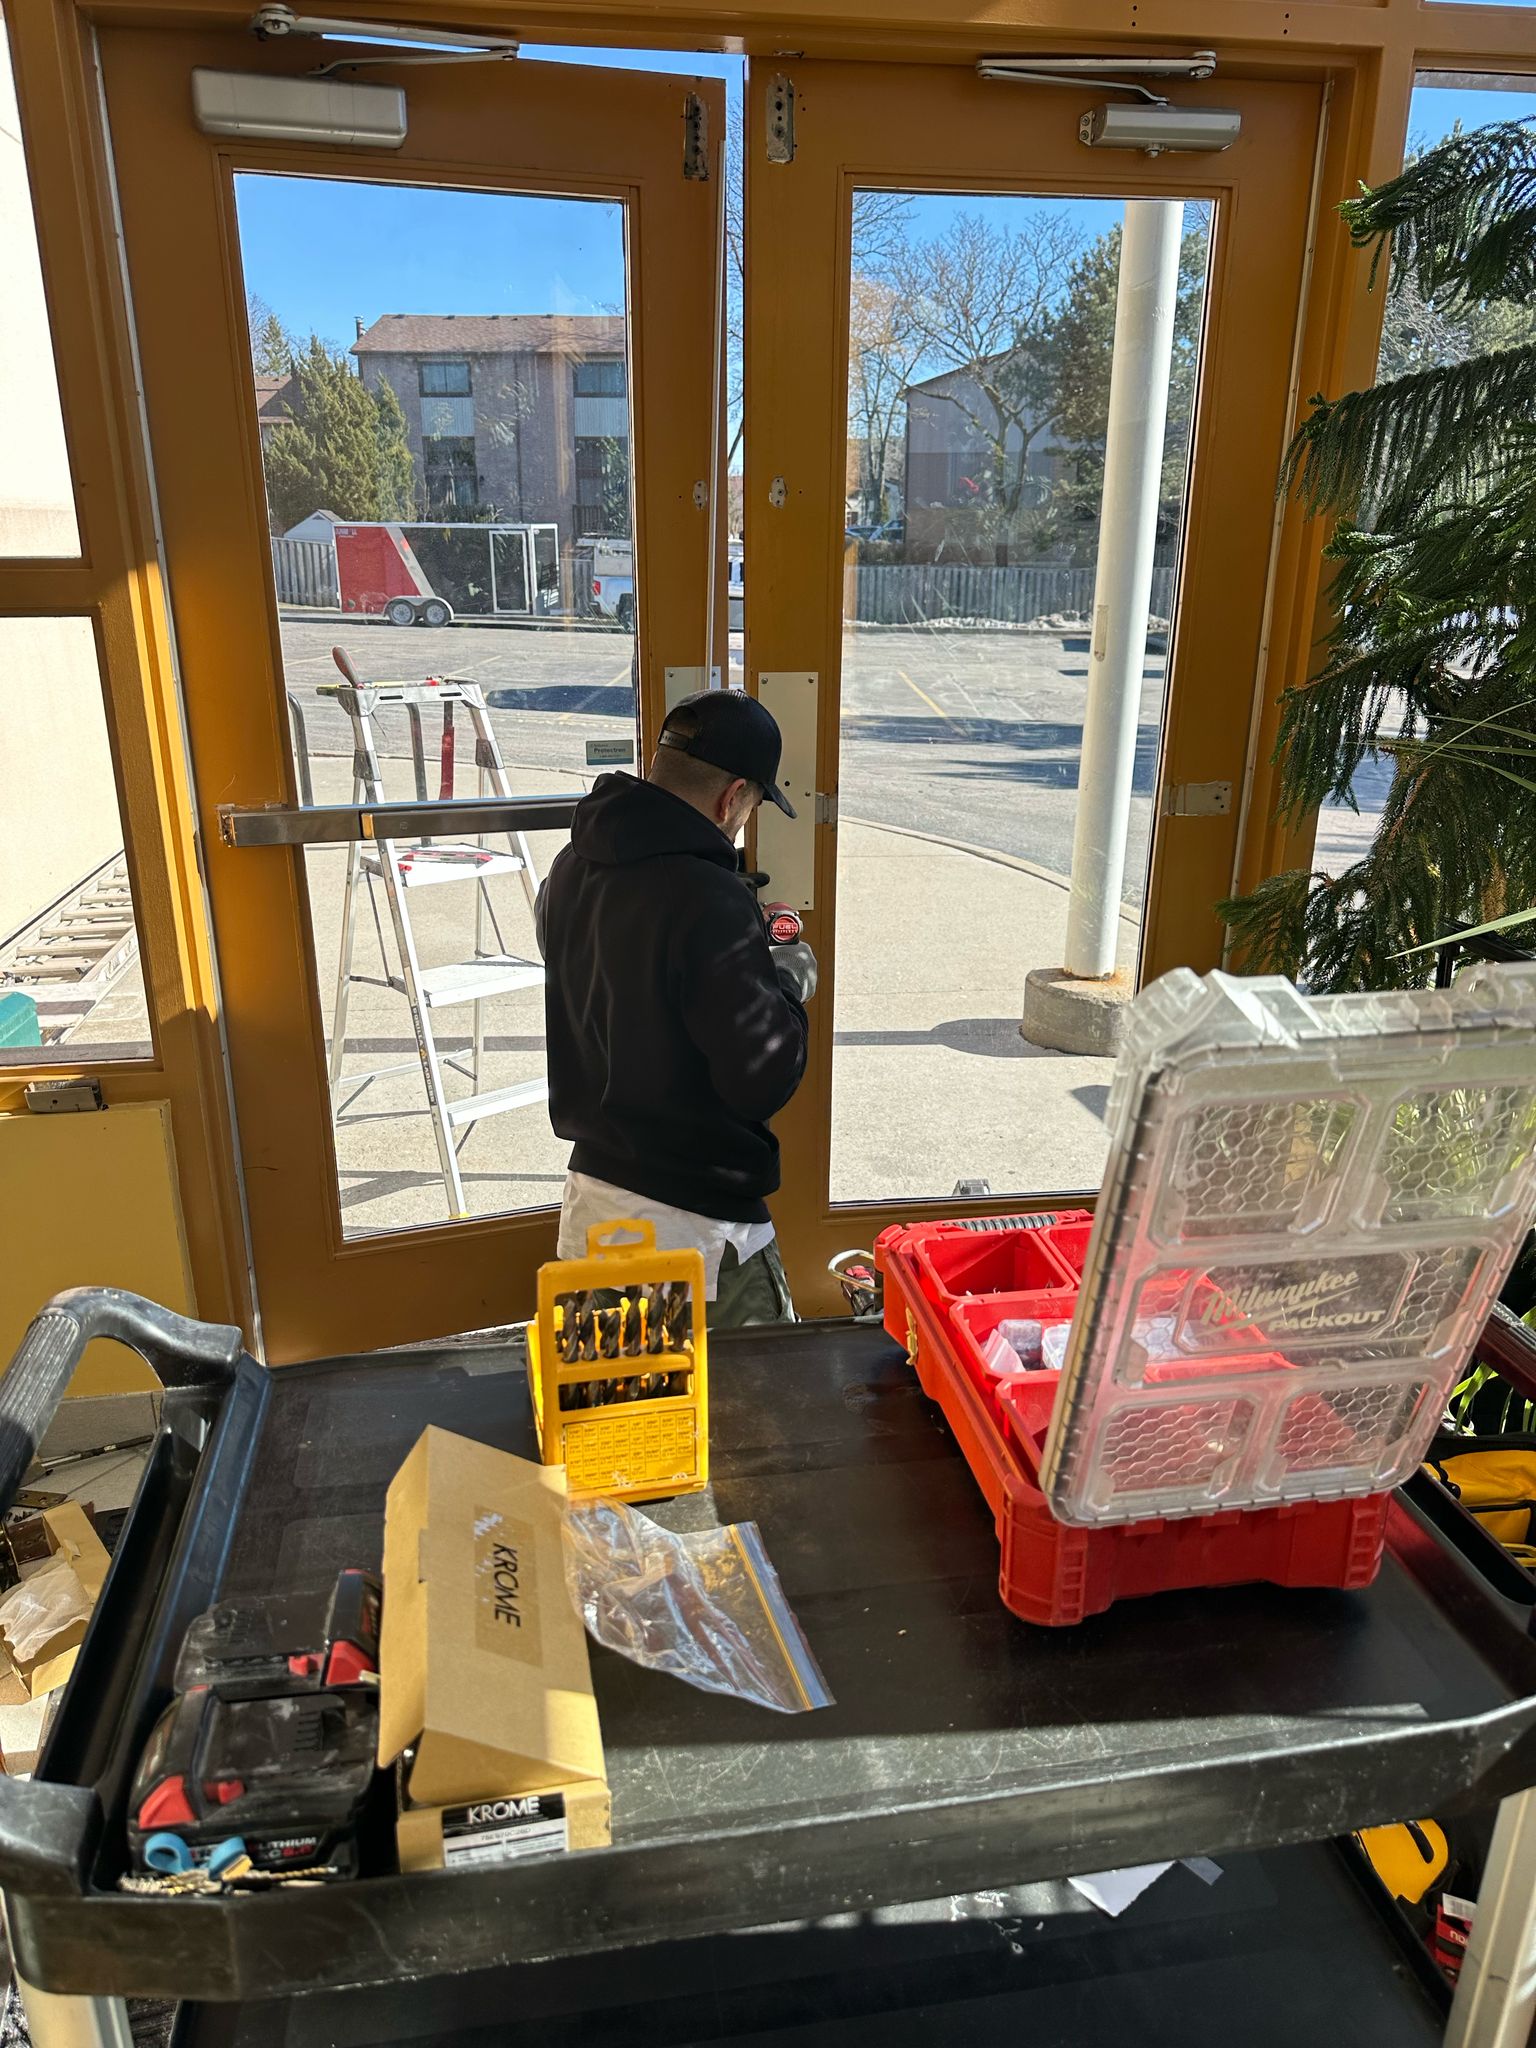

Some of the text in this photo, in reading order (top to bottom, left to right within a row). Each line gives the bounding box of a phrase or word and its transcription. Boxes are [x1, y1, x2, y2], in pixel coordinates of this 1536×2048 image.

[411, 1006, 435, 1103] GORILLA LADDERS
[1200, 1270, 1361, 1327] Milwaukee
[1267, 1309, 1387, 1332] PACKOUT
[492, 1542, 522, 1628] KROME
[468, 1796, 540, 1825] KROME
